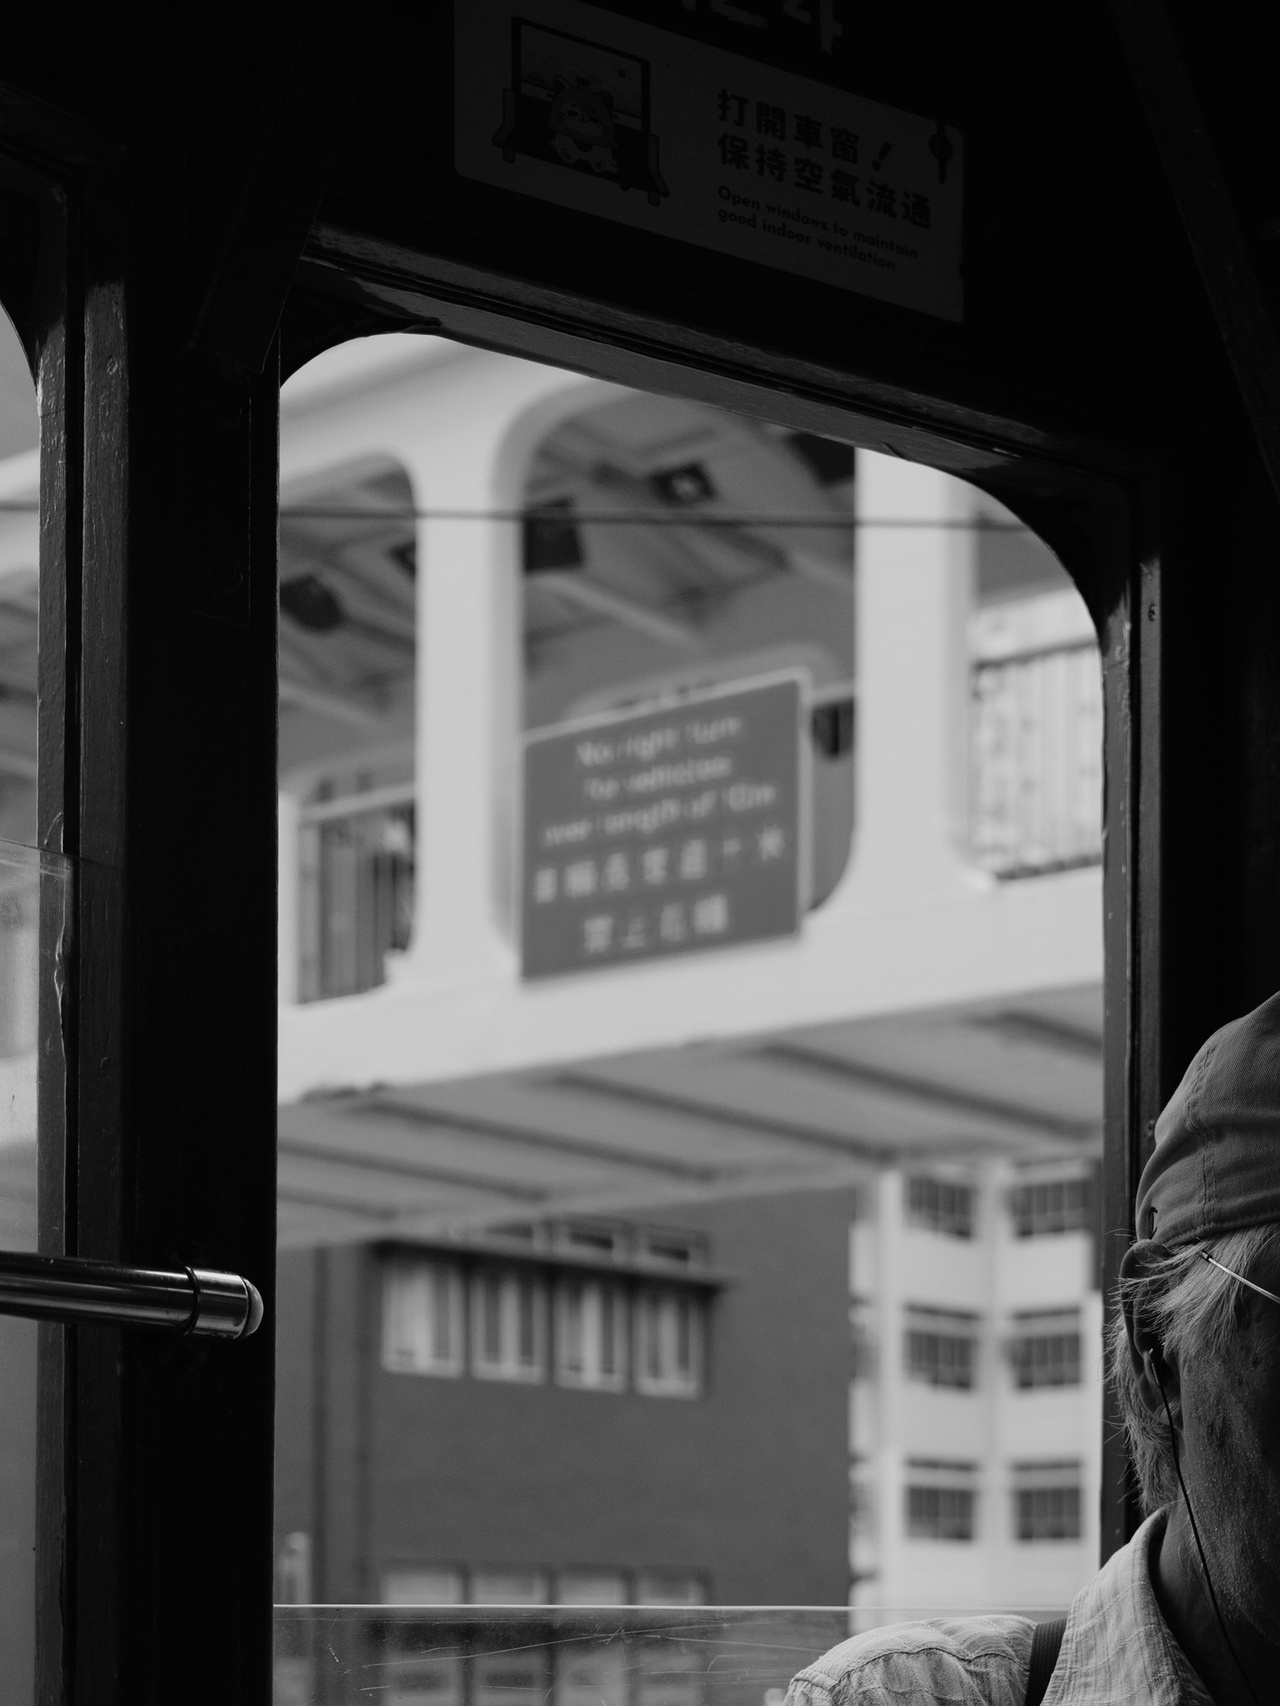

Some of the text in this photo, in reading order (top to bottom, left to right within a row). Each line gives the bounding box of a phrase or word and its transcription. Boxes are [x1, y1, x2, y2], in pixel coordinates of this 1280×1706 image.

[716, 132, 932, 229] 保持空氣流通
[717, 185, 919, 259] Open windows to maintain
[717, 207, 897, 272] good indoor ventilation
